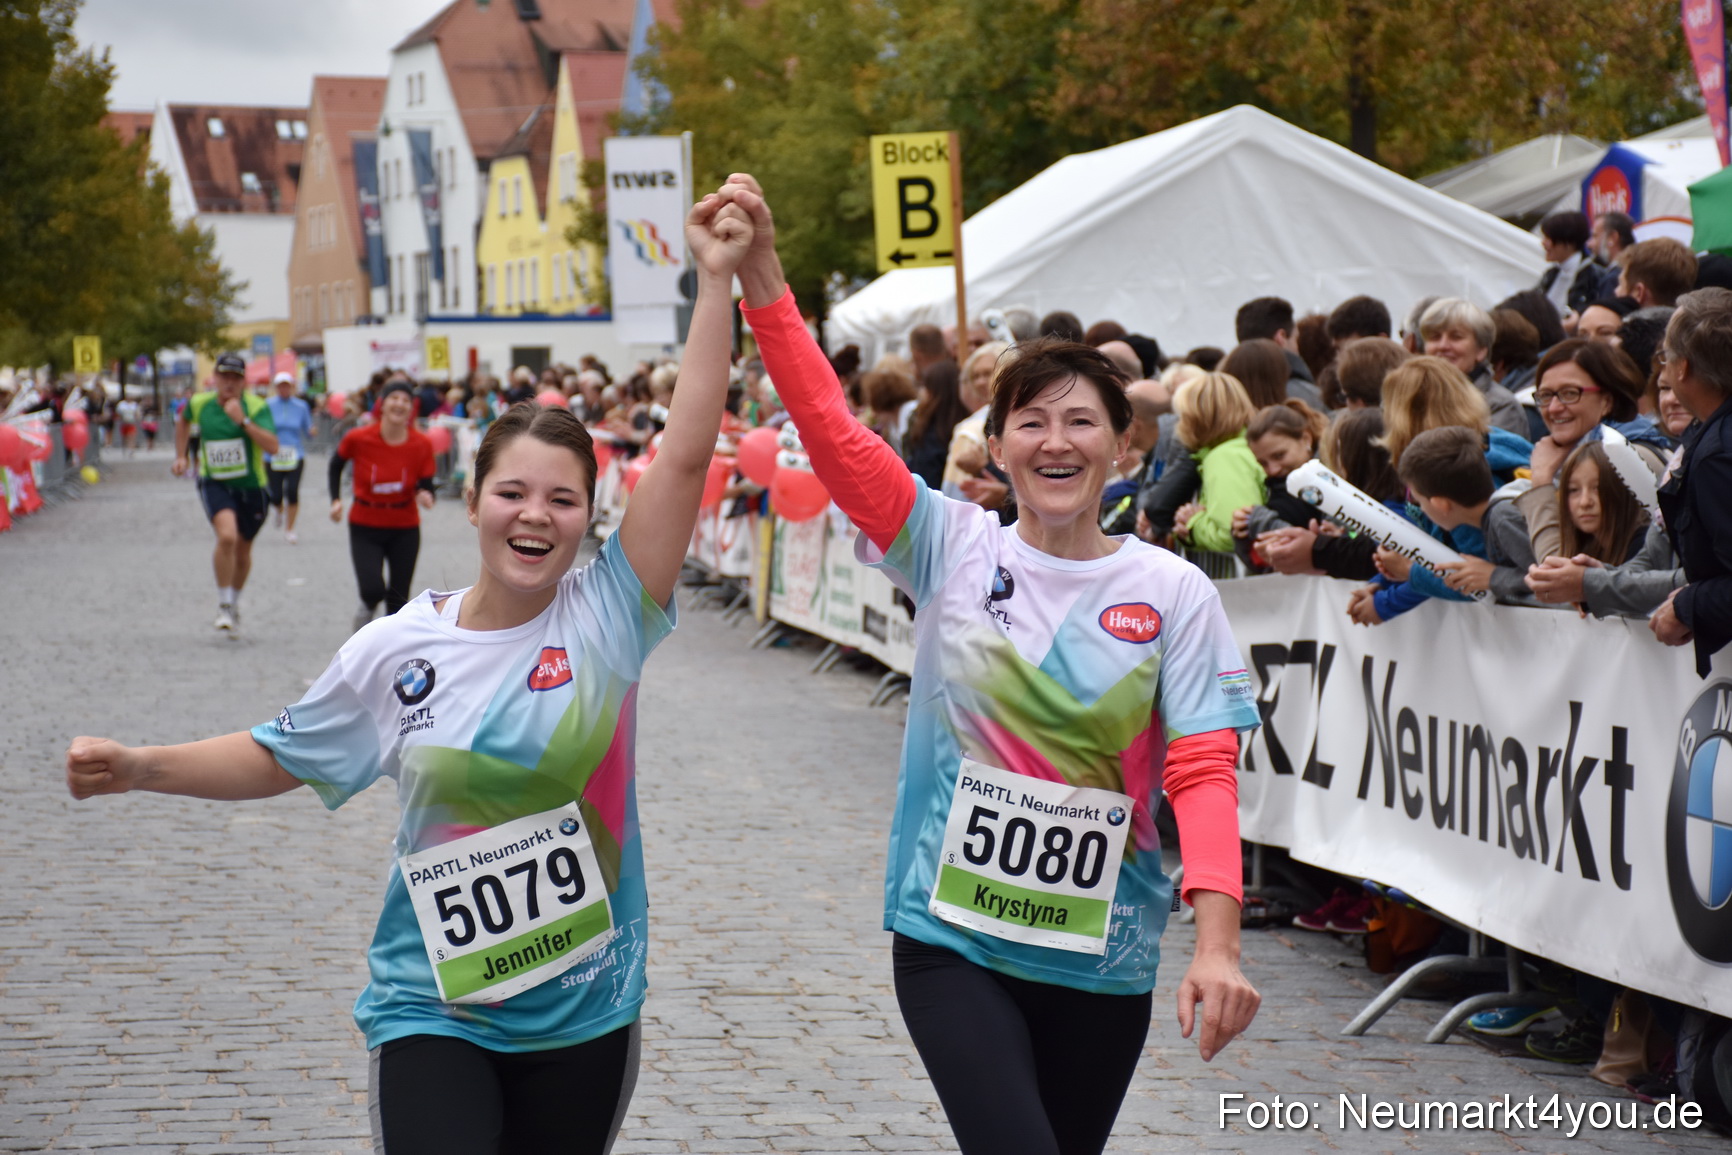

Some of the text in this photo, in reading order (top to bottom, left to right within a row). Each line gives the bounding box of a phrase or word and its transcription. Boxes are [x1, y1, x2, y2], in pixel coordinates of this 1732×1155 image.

[883, 139, 949, 165] Block
[898, 177, 939, 239] B
[1109, 611, 1155, 633] Hervis
[396, 660, 432, 680] BMW
[537, 657, 569, 678] ervis
[398, 720, 434, 737] eumarkt
[1357, 655, 1635, 891] Neumarkt
[961, 776, 1100, 822] PARTL Neumarkt
[409, 828, 554, 887] PARTL Neumarkt
[948, 853, 955, 864] S
[963, 805, 1108, 890] 5080
[434, 847, 586, 947] 5079
[974, 884, 1069, 926] Krystyna
[437, 949, 445, 961] S
[483, 928, 573, 981] Jennifer
[620, 957, 639, 996] September
[635, 941, 646, 958] 2015
